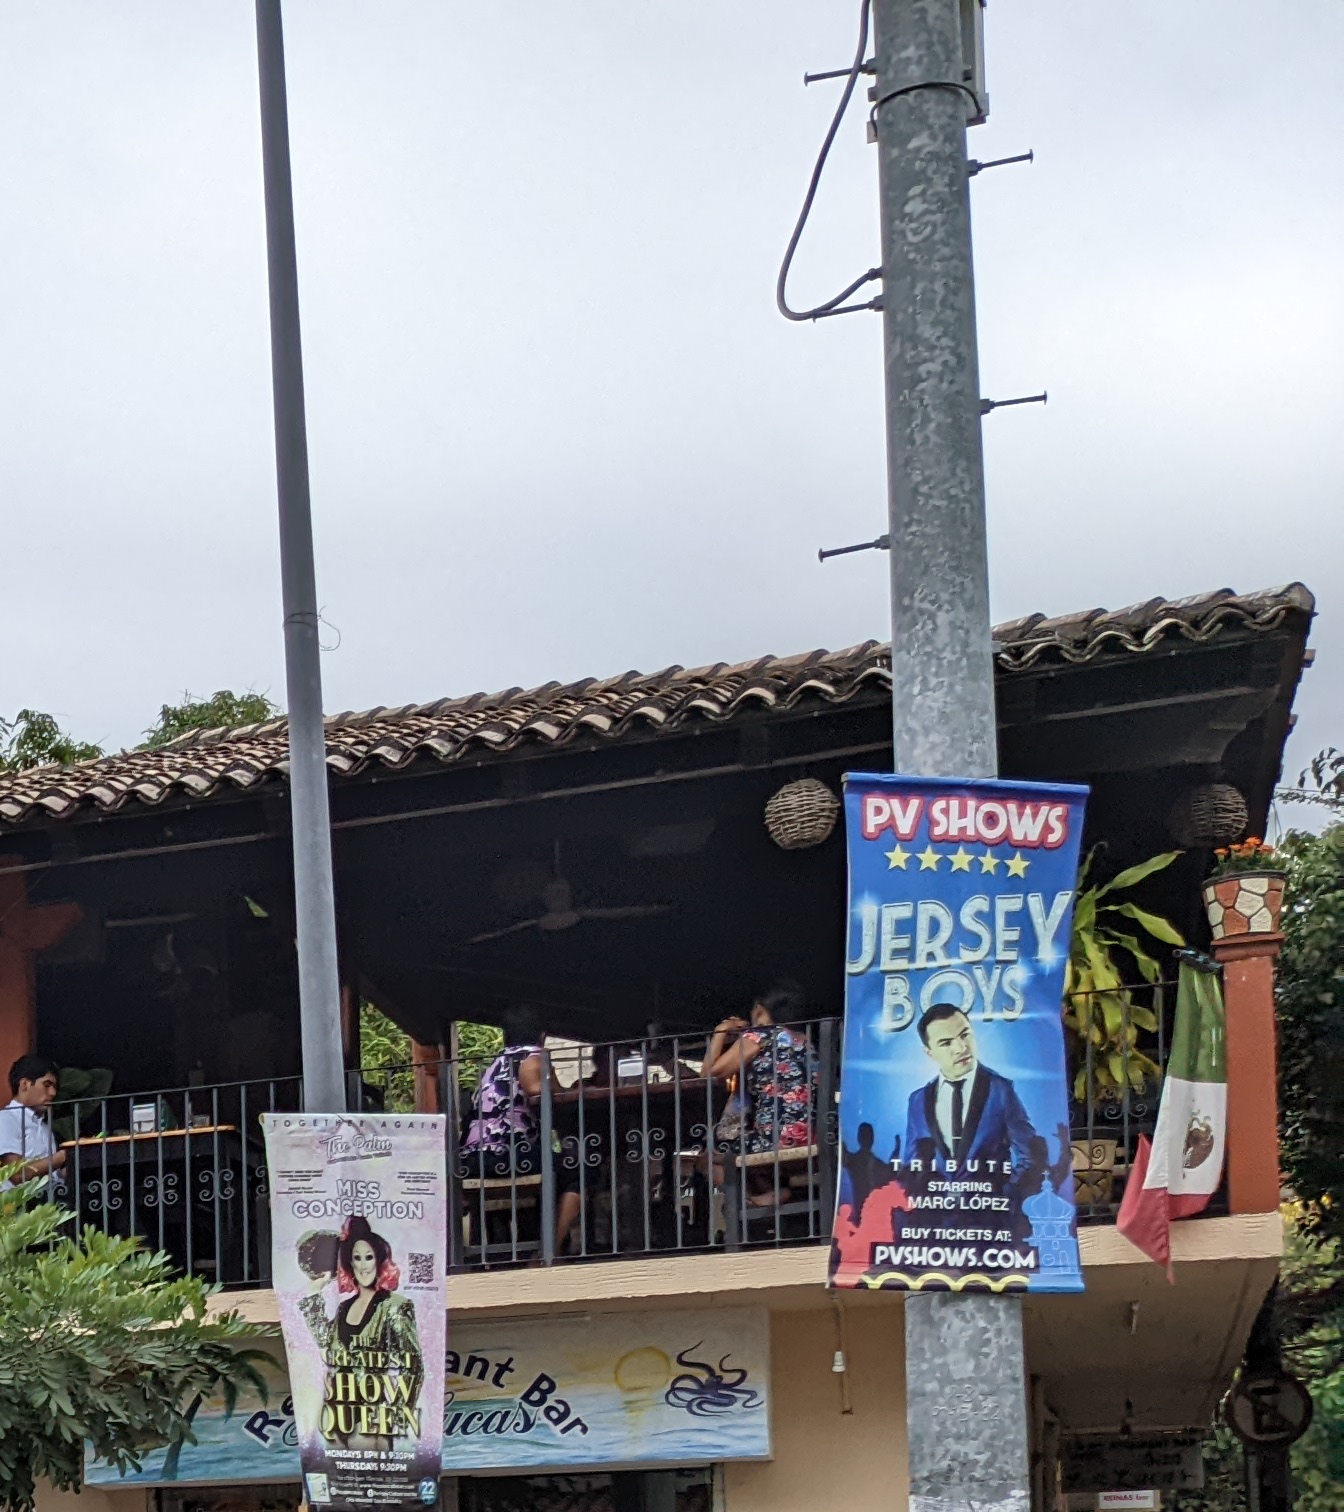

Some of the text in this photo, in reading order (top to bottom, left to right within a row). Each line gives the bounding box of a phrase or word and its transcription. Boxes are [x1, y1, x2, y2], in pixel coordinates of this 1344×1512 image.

[864, 796, 1068, 848] PV SHOWS
[846, 890, 1075, 975] JERSEY
[881, 965, 1027, 1035] BOYS
[272, 1118, 438, 1130] TOGETHER AGAIN
[319, 1135, 350, 1158] The
[352, 1134, 392, 1152] Palm
[890, 1157, 1012, 1175] TRIBUTE
[336, 1179, 381, 1200] MISS
[927, 1180, 992, 1194] STARRING
[292, 1200, 424, 1220] CONCEPTION
[907, 1192, 1010, 1213] MARC LÓPEZ
[901, 1227, 1013, 1242] BUY TICKETS AT:
[874, 1245, 1036, 1271] PVSHOWS.COM
[320, 1348, 414, 1369] GREATEST
[323, 1371, 416, 1404] SHOW
[519, 1372, 591, 1440] Bar
[318, 1404, 422, 1440] QUEEN
[443, 1397, 541, 1437] ucas
[324, 1450, 362, 1459] MONDAYS
[335, 1461, 379, 1471] THURSDAYS
